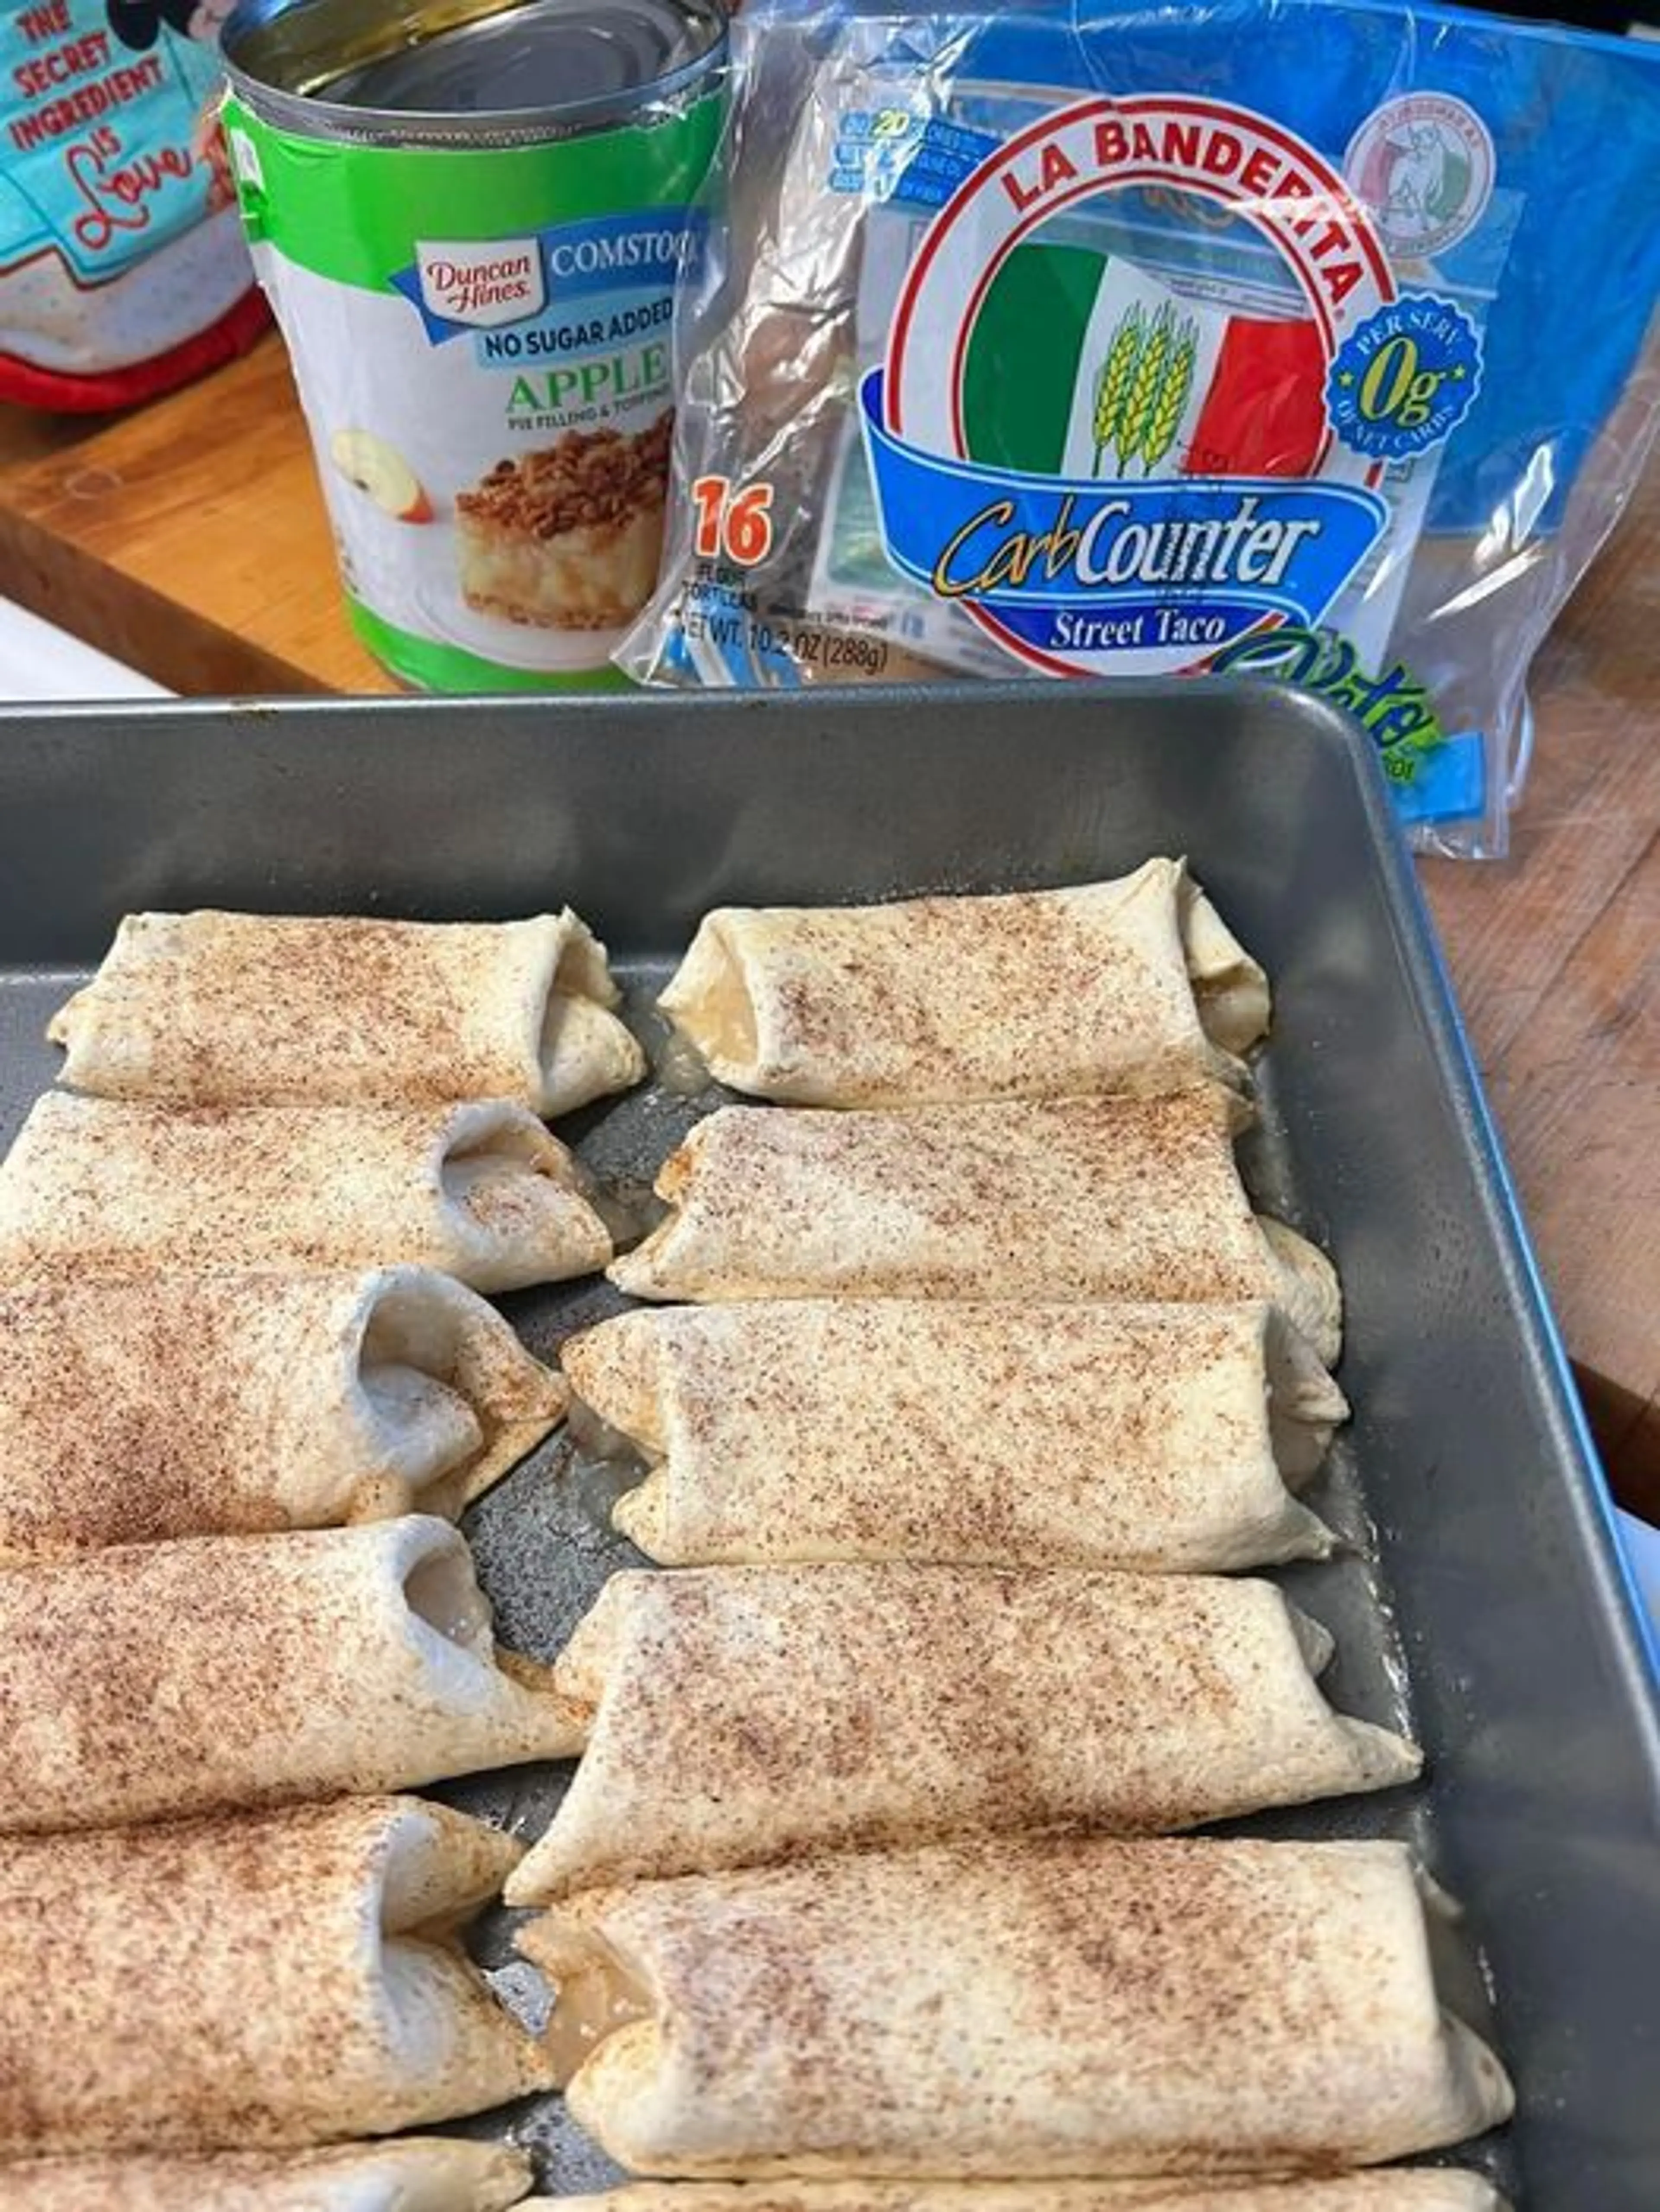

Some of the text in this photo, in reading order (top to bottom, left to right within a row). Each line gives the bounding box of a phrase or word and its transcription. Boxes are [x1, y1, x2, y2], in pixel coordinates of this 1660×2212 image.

[16, 1, 73, 42] THE
[12, 31, 111, 98] SECRET
[7, 55, 164, 151] INGREDIENT
[91, 127, 121, 156] IS
[66, 145, 192, 249] Love
[1001, 143, 1078, 212] LA
[1093, 120, 1367, 304] BANDERITA
[427, 256, 530, 290] Duncan
[485, 297, 673, 358] NO SUGAR ADDED
[1357, 315, 1403, 355] PER
[506, 345, 666, 412] APPLE
[536, 406, 597, 428] FILLING
[693, 475, 774, 565] 16
[1050, 609, 1226, 648] Street Taco
